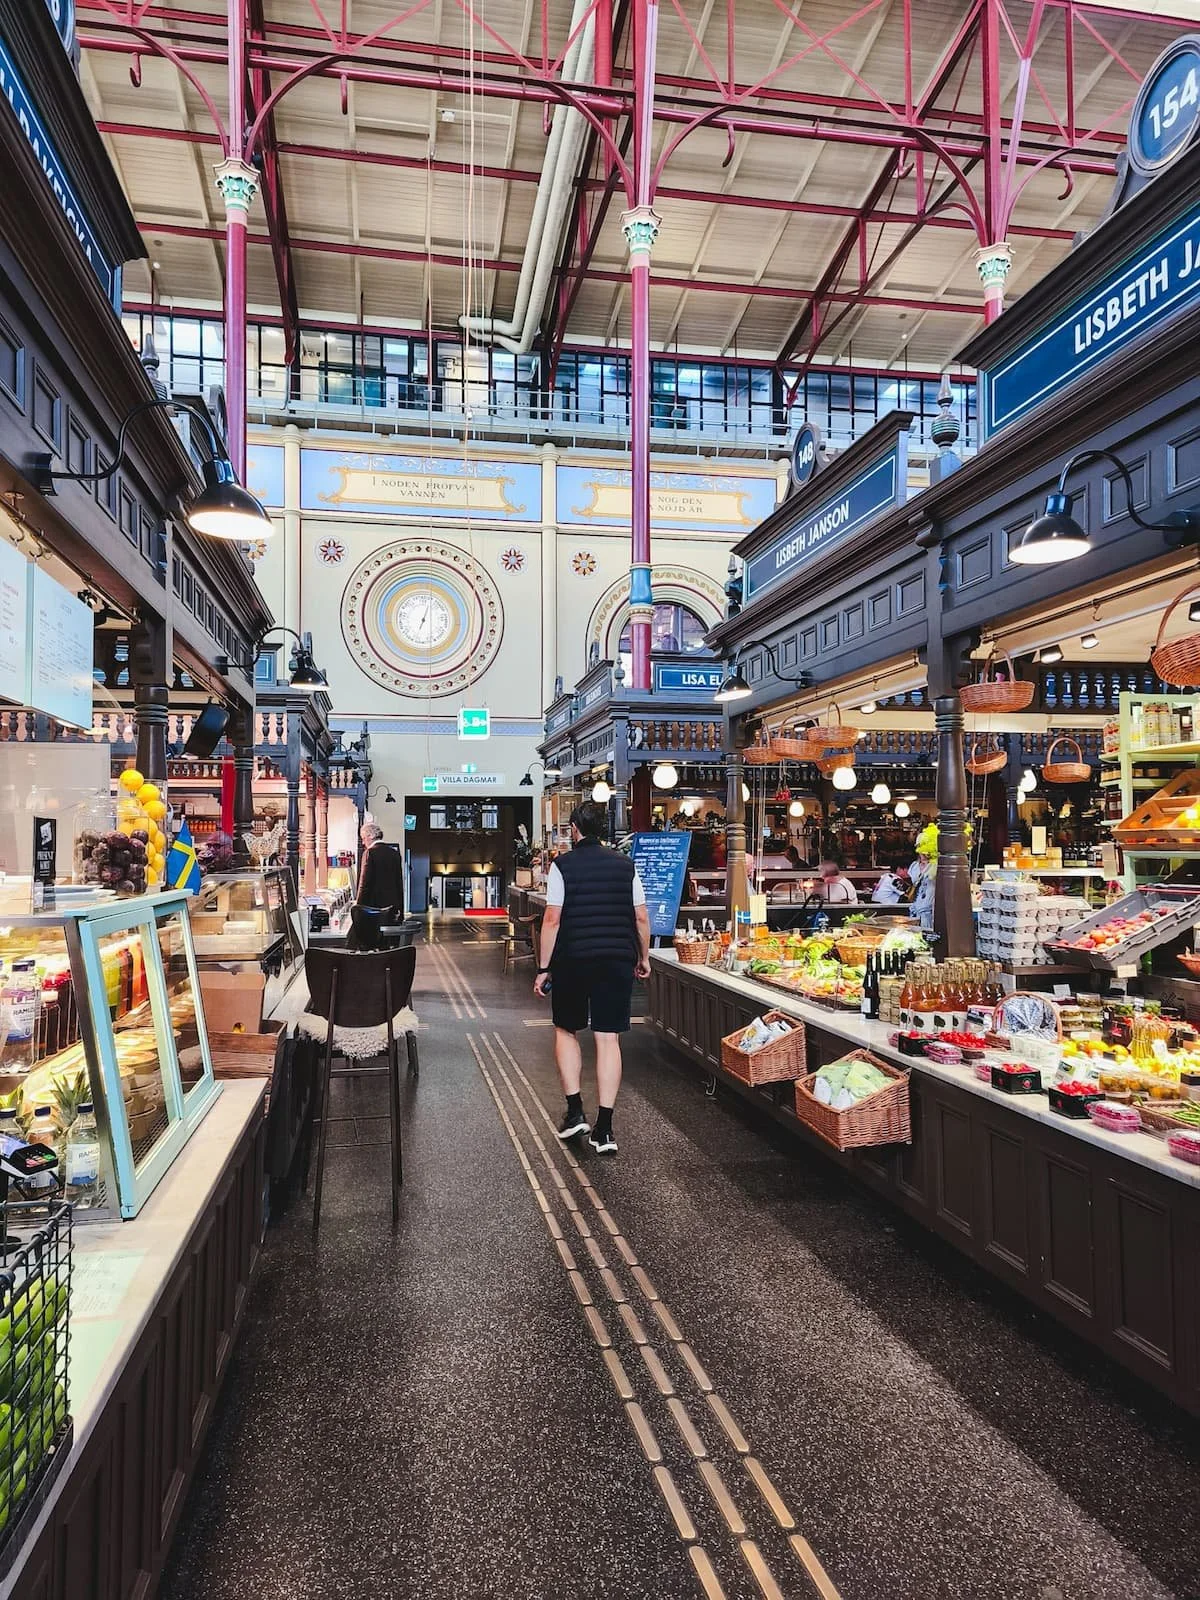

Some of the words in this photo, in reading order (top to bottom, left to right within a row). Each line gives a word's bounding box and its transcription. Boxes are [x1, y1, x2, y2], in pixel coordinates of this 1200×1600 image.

[1149, 68, 1199, 139] 154
[1074, 257, 1169, 355] LISBETH
[798, 442, 813, 468] 148
[775, 532, 806, 569] LISBETH
[807, 500, 850, 547] JANSON
[682, 673, 707, 685] LISA
[709, 674, 724, 686] EL
[463, 776, 497, 784] DAGMAR
